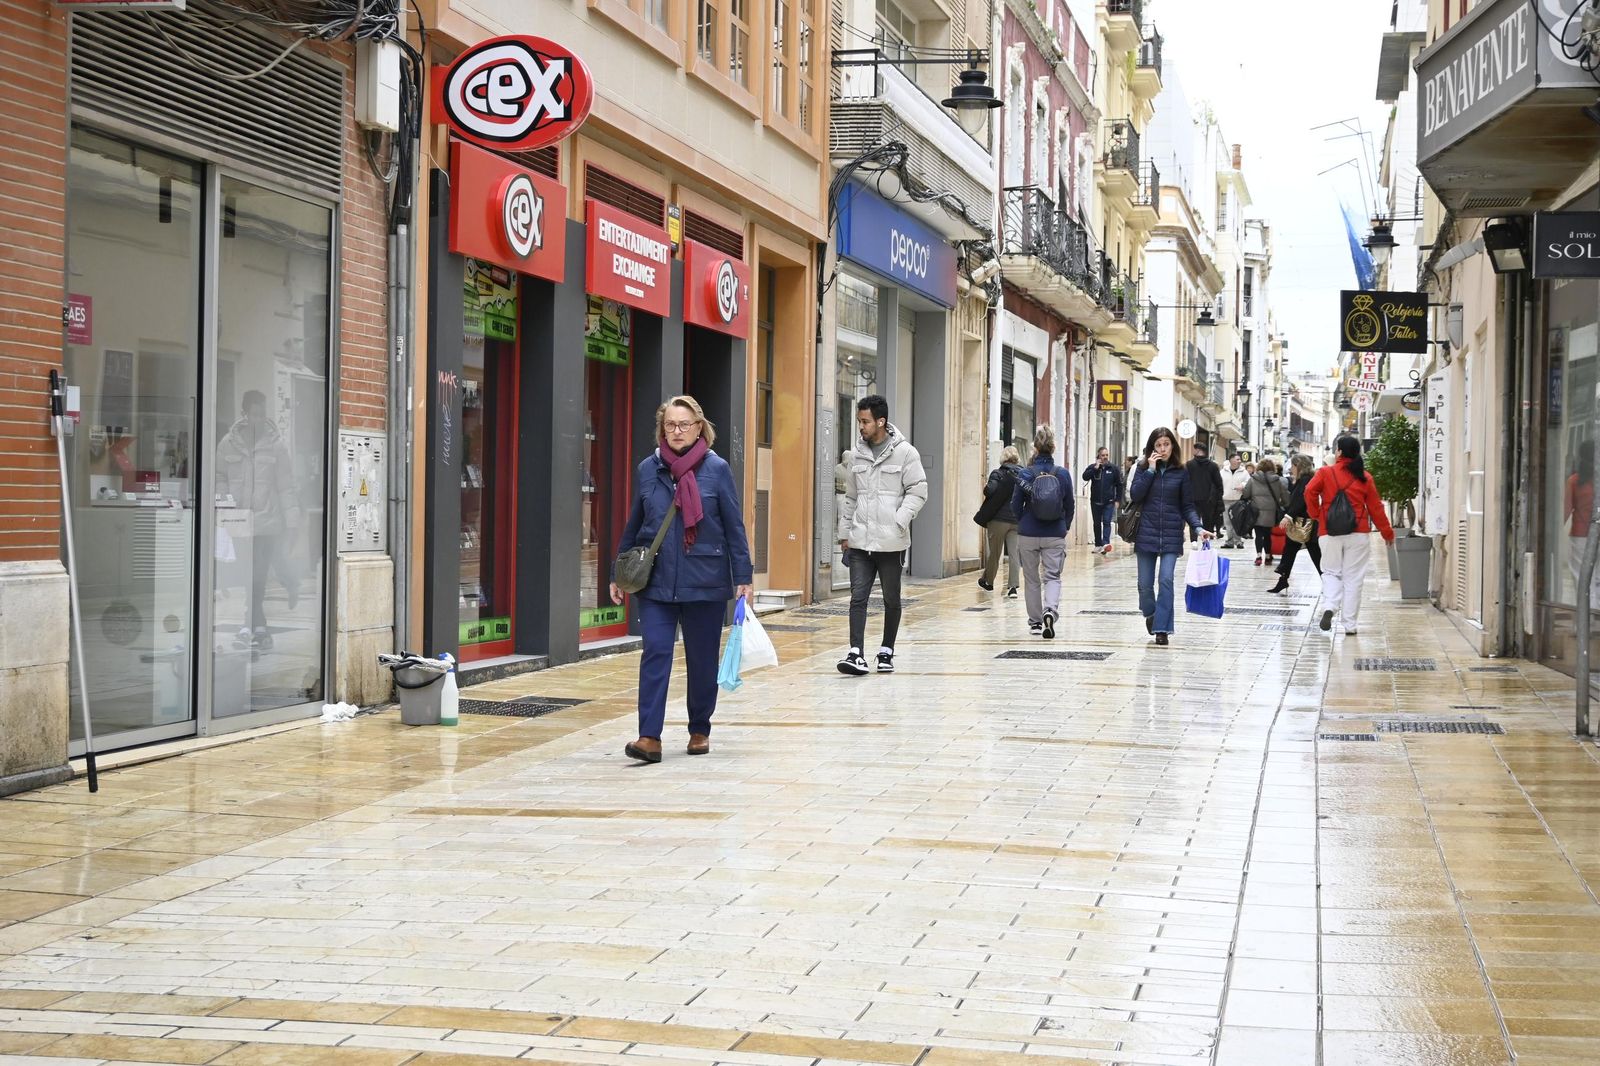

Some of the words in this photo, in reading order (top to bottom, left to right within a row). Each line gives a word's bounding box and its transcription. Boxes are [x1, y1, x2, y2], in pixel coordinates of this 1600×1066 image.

[1424, 3, 1529, 138] BENAVENTE
[598, 217, 669, 264] ENTERTAINMENT
[890, 228, 928, 279] pepco
[612, 253, 656, 288] EXCHANGE
[1389, 325, 1419, 339] Taller
[1349, 379, 1387, 392] CHINO
